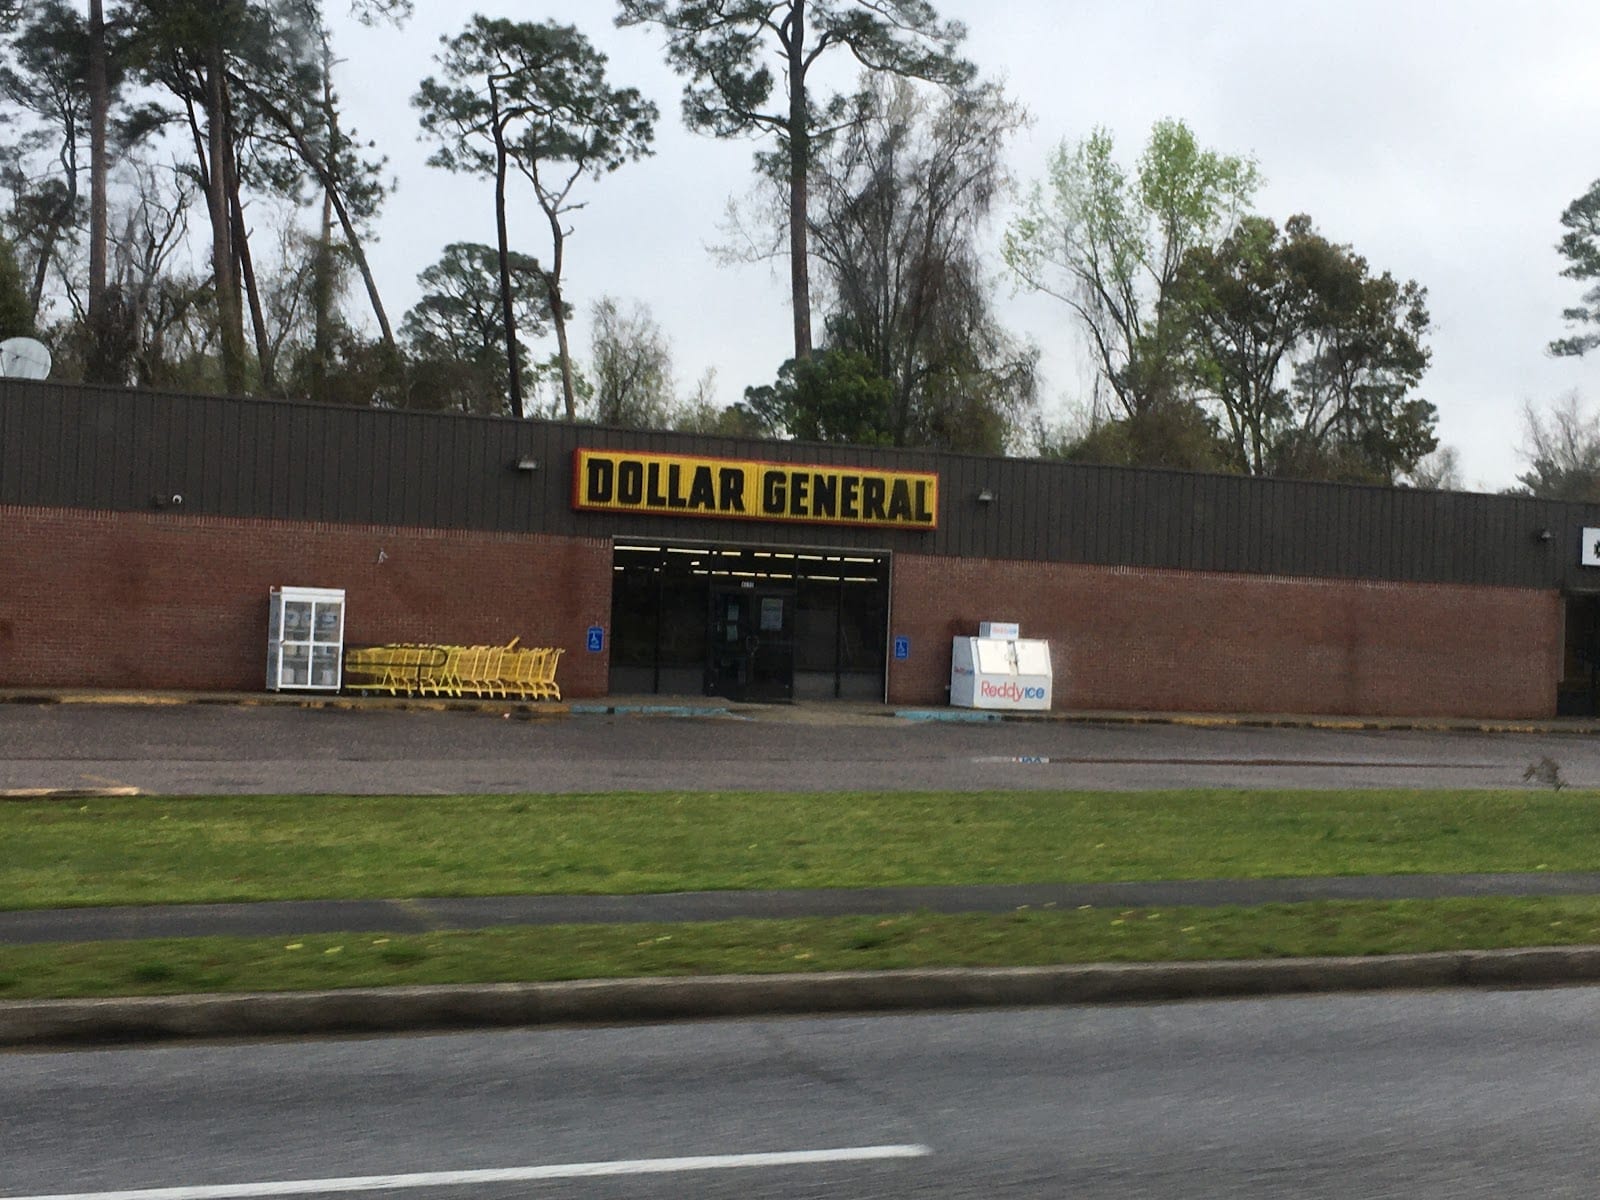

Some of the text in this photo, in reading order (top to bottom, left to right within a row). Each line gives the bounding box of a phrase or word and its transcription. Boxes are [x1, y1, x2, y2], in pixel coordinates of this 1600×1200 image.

[586, 457, 932, 522] DOLLAR GENERAL
[980, 680, 1024, 703] Reddy
